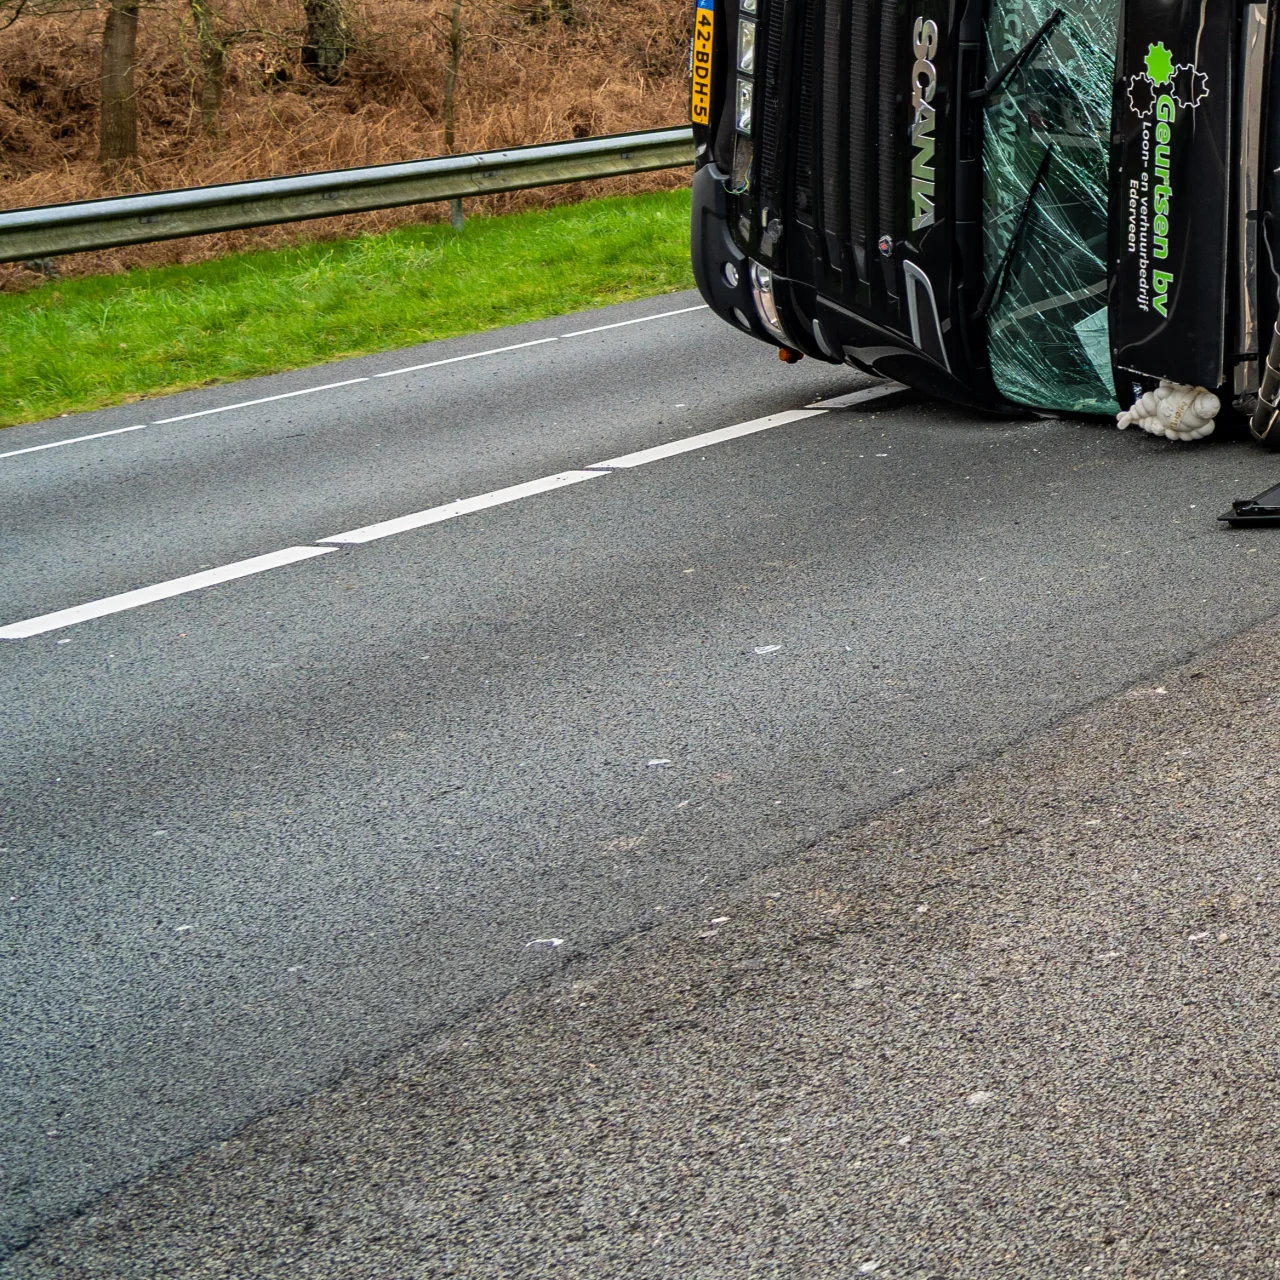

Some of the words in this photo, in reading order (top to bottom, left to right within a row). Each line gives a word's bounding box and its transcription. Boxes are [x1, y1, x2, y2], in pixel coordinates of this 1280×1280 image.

[693, 14, 712, 117] 42-BDH-5
[911, 16, 938, 232] SCANIA
[1141, 122, 1151, 168] Loon-
[1128, 179, 1139, 252] Ederveen
[1141, 172, 1149, 191] en
[1153, 94, 1175, 259] Geurtsen
[1137, 196, 1150, 312] verhuurbedrijf
[1152, 269, 1174, 318] bv
